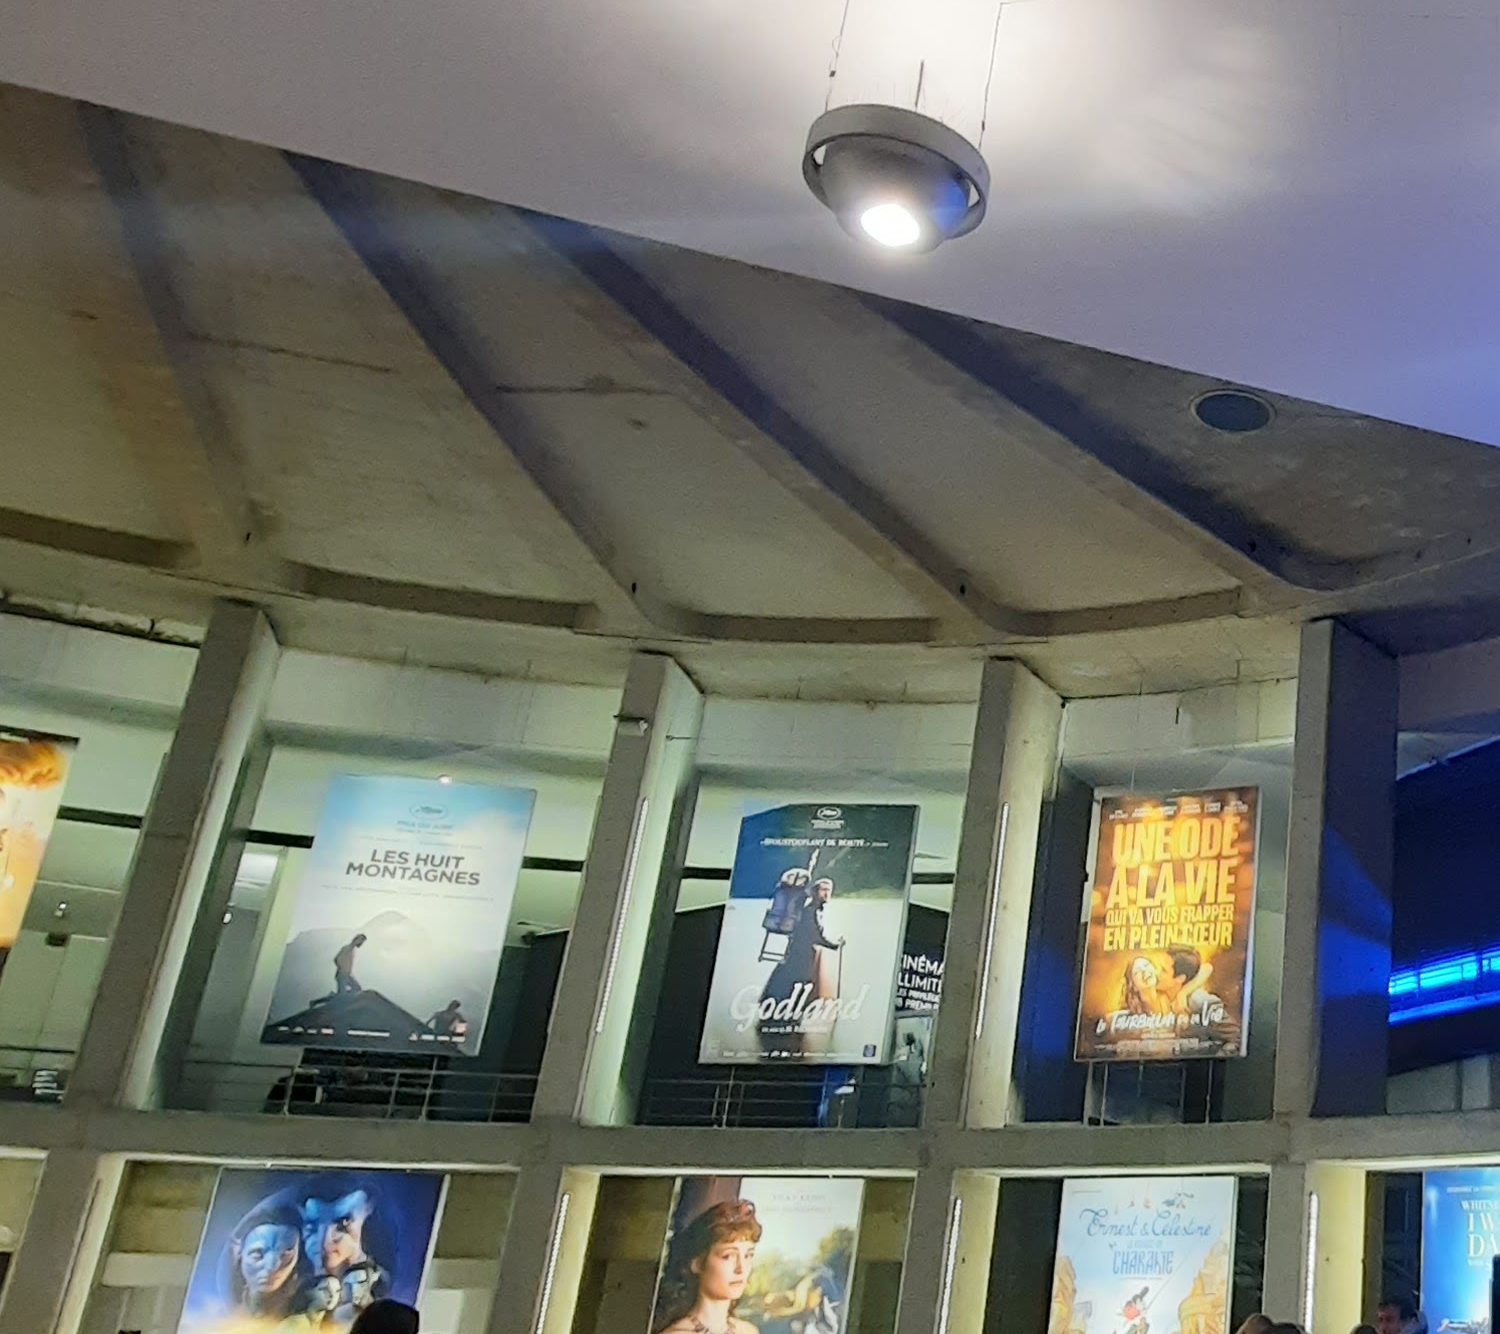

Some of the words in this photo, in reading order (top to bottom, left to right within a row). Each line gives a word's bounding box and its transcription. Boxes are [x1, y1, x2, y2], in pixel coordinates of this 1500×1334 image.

[1112, 821, 1173, 864] UNE
[1178, 816, 1241, 860] ODE
[371, 849, 409, 865] LES
[414, 853, 464, 869] HUIT
[345, 862, 481, 886] MONTAGNES
[1136, 861, 1176, 908] LA
[1184, 858, 1239, 905] VIE
[1105, 908, 1127, 926] QUI
[1128, 907, 1144, 926] VA
[1146, 905, 1179, 925] VOUS
[1180, 903, 1235, 924] FRAPPER
[1104, 926, 1127, 952] EN
[1128, 923, 1178, 950] PLEIN
[730, 982, 871, 1033] Godland
[1079, 1208, 1138, 1237] Ernest
[1468, 1212, 1476, 1232] I
